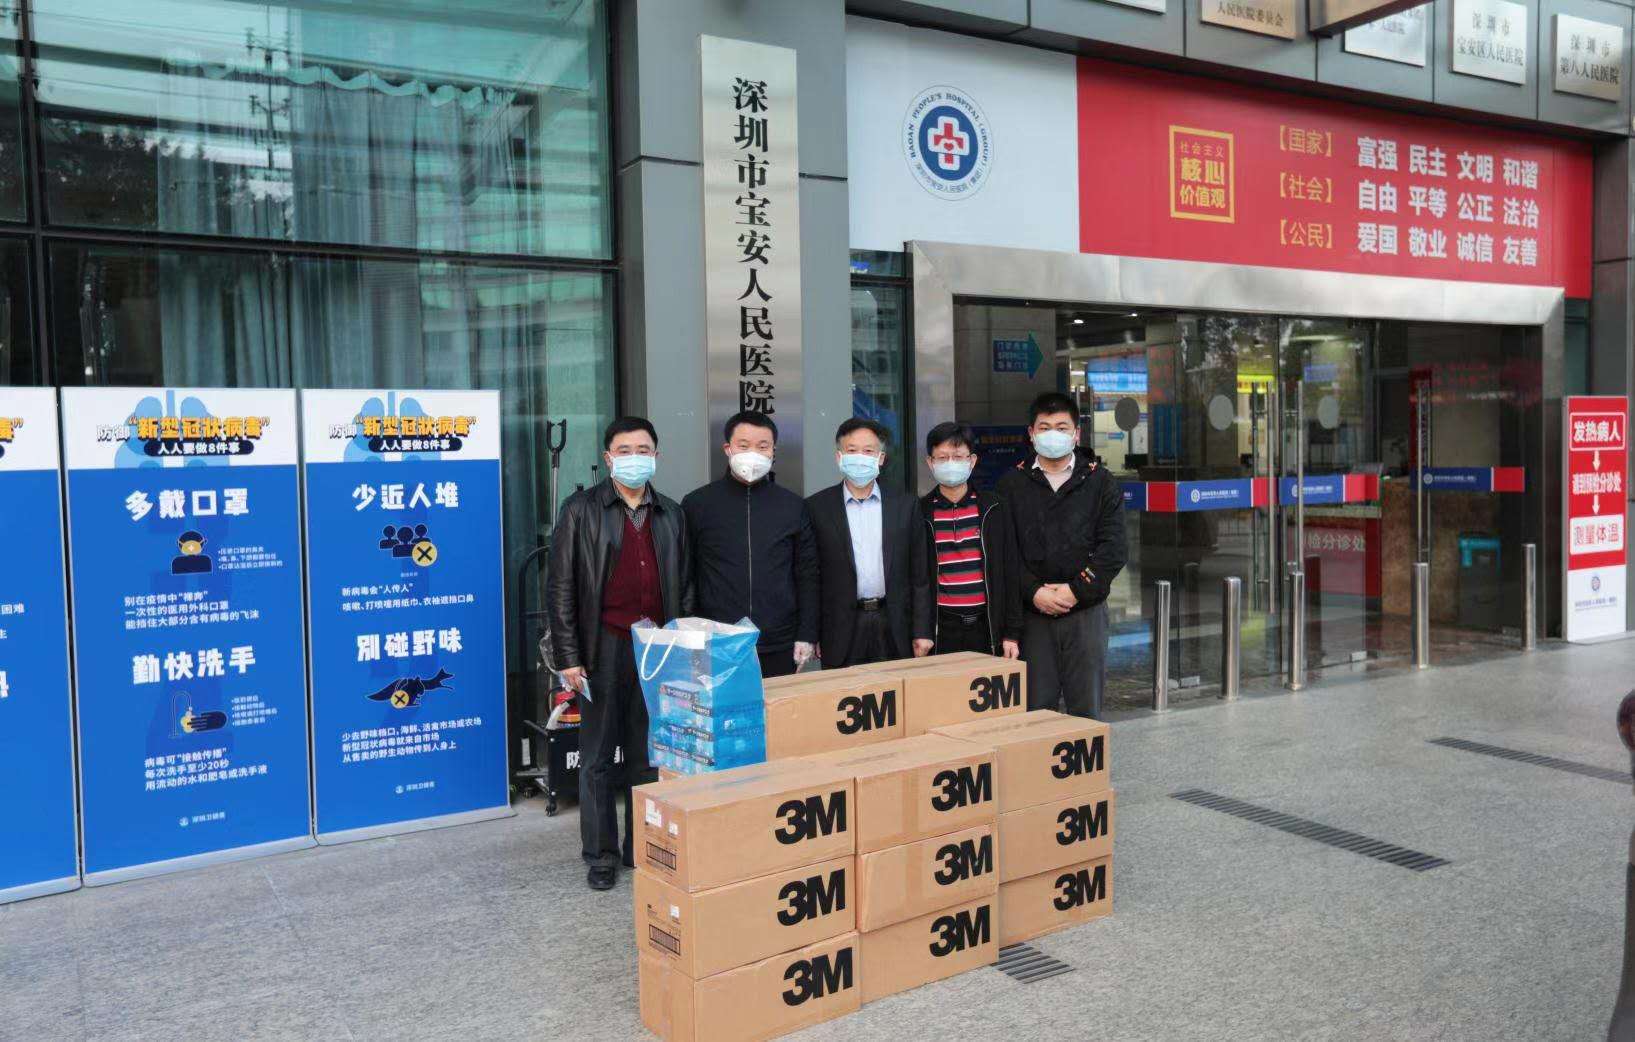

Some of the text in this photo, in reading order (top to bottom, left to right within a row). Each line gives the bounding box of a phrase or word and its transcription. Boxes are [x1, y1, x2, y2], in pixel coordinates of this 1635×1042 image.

[1180, 140, 1224, 158] 社会主义
[1180, 157, 1225, 186] 核心
[1357, 136, 1539, 190] 富强 民主 文明 和谐
[1180, 184, 1226, 209] 价值观
[1358, 179, 1540, 230] 自由 平等 公正 法治
[732, 77, 775, 415] 深圳市宝安人民医院
[1357, 222, 1537, 267] 爱国 敬业 诚信 友善
[1573, 420, 1621, 443] 发热病人
[125, 488, 249, 522] 多戴口罩
[352, 482, 459, 511] 少近人堆
[132, 646, 256, 685] 勤快洗手
[357, 627, 463, 662] 别碰野味
[837, 690, 896, 734] 3M
[969, 673, 1020, 712] 3M
[1052, 736, 1103, 779] 3M
[932, 763, 992, 811] 3M
[775, 791, 846, 844] 3M
[1056, 800, 1107, 845] 3M
[935, 835, 992, 885] 3M
[777, 869, 845, 926] 3M
[1054, 865, 1106, 911] 3M
[930, 905, 990, 957] 3M
[783, 947, 852, 1006] 3M
